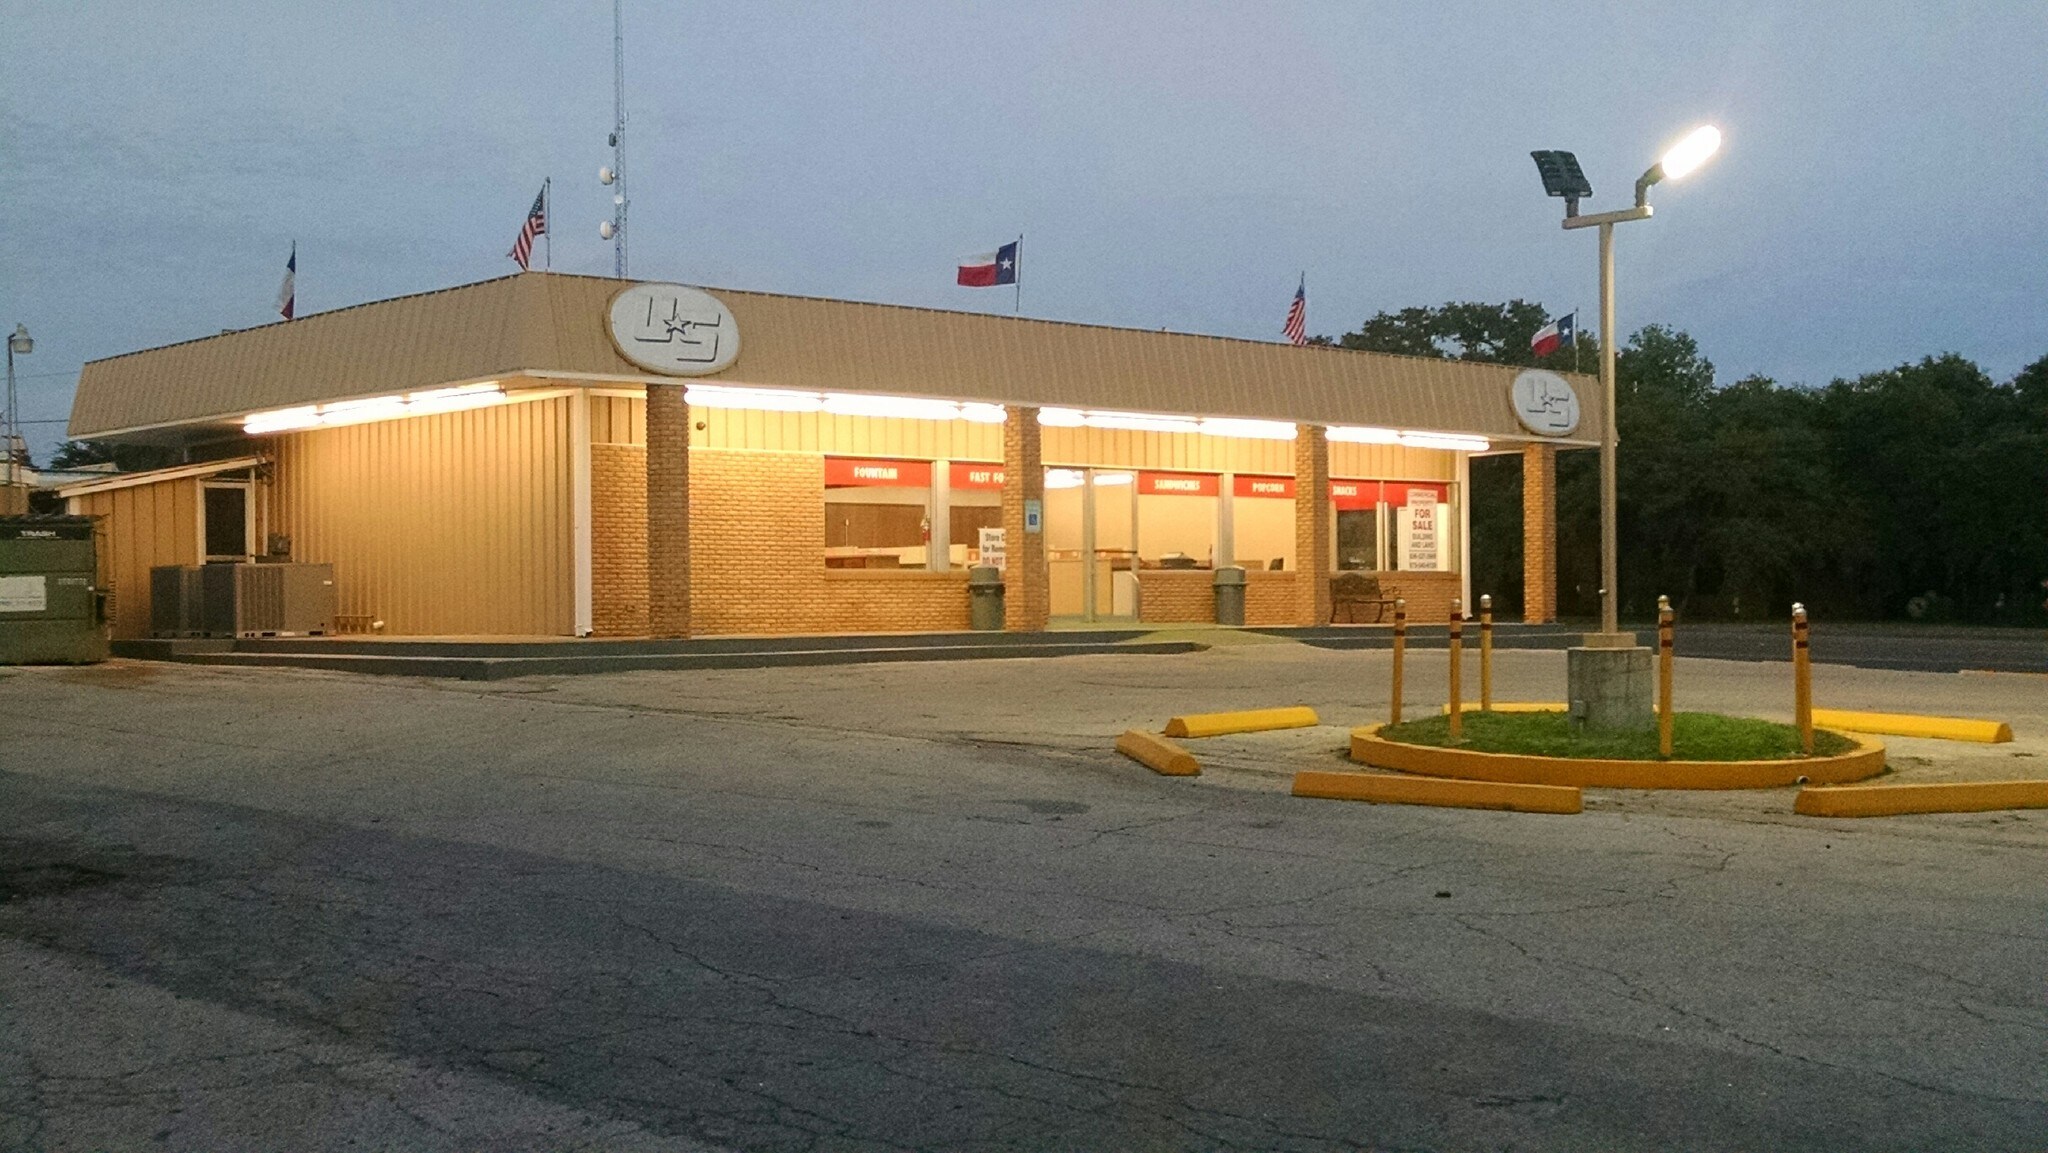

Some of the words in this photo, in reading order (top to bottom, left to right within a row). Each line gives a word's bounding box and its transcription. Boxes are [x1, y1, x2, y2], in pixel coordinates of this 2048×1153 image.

[854, 466, 898, 480] FOUNTAIN
[969, 471, 991, 483] FAST
[993, 472, 1004, 484] FO
[1154, 479, 1201, 491] SANDWICHES
[1252, 482, 1285, 493] POPCORN
[1332, 485, 1357, 497] SNACKS
[1414, 508, 1431, 519] FOR
[1412, 520, 1433, 531] SALE
[984, 532, 1000, 542] Store
